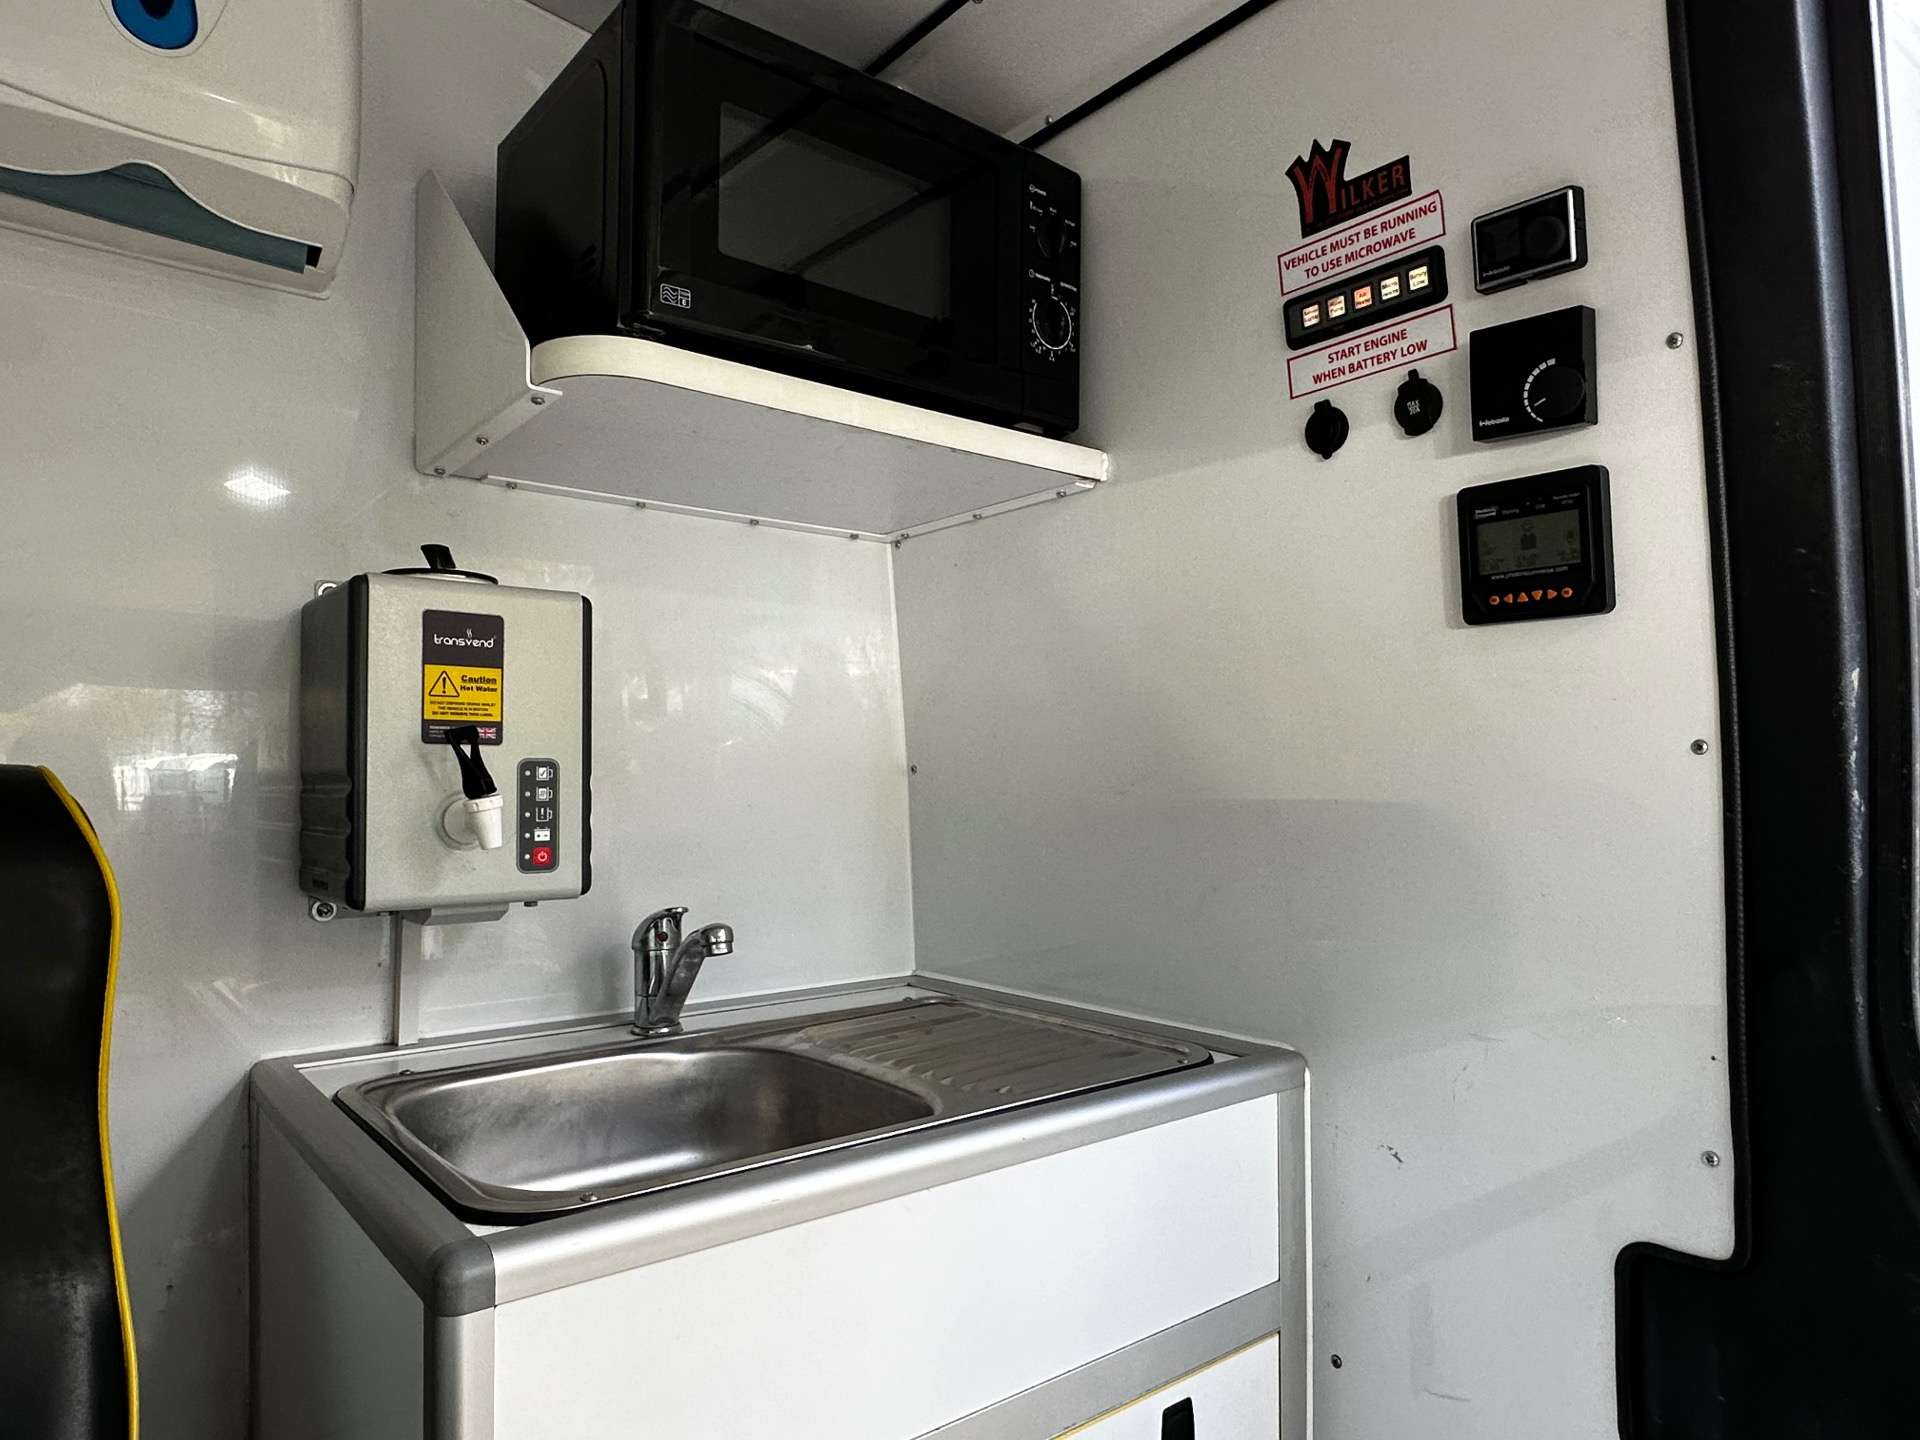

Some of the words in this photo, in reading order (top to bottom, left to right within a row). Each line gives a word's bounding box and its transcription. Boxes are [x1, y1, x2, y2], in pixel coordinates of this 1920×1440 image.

[1293, 147, 1404, 224] WILKER
[1284, 245, 1328, 270] VEHICLE
[1330, 232, 1361, 253] MUST
[1363, 224, 1378, 240] BE
[1380, 201, 1437, 233] RUNNING
[1304, 266, 1319, 279] TO
[1321, 256, 1343, 272] USE
[1345, 228, 1416, 264] MICROWAVE
[1312, 366, 1346, 385] WHEN
[1348, 349, 1398, 374] BATTERY
[1400, 340, 1428, 357] LOW
[1328, 343, 1362, 364] START
[1363, 329, 1408, 352] ENGINE
[433, 633, 494, 648] transvend
[461, 674, 497, 684] Caution
